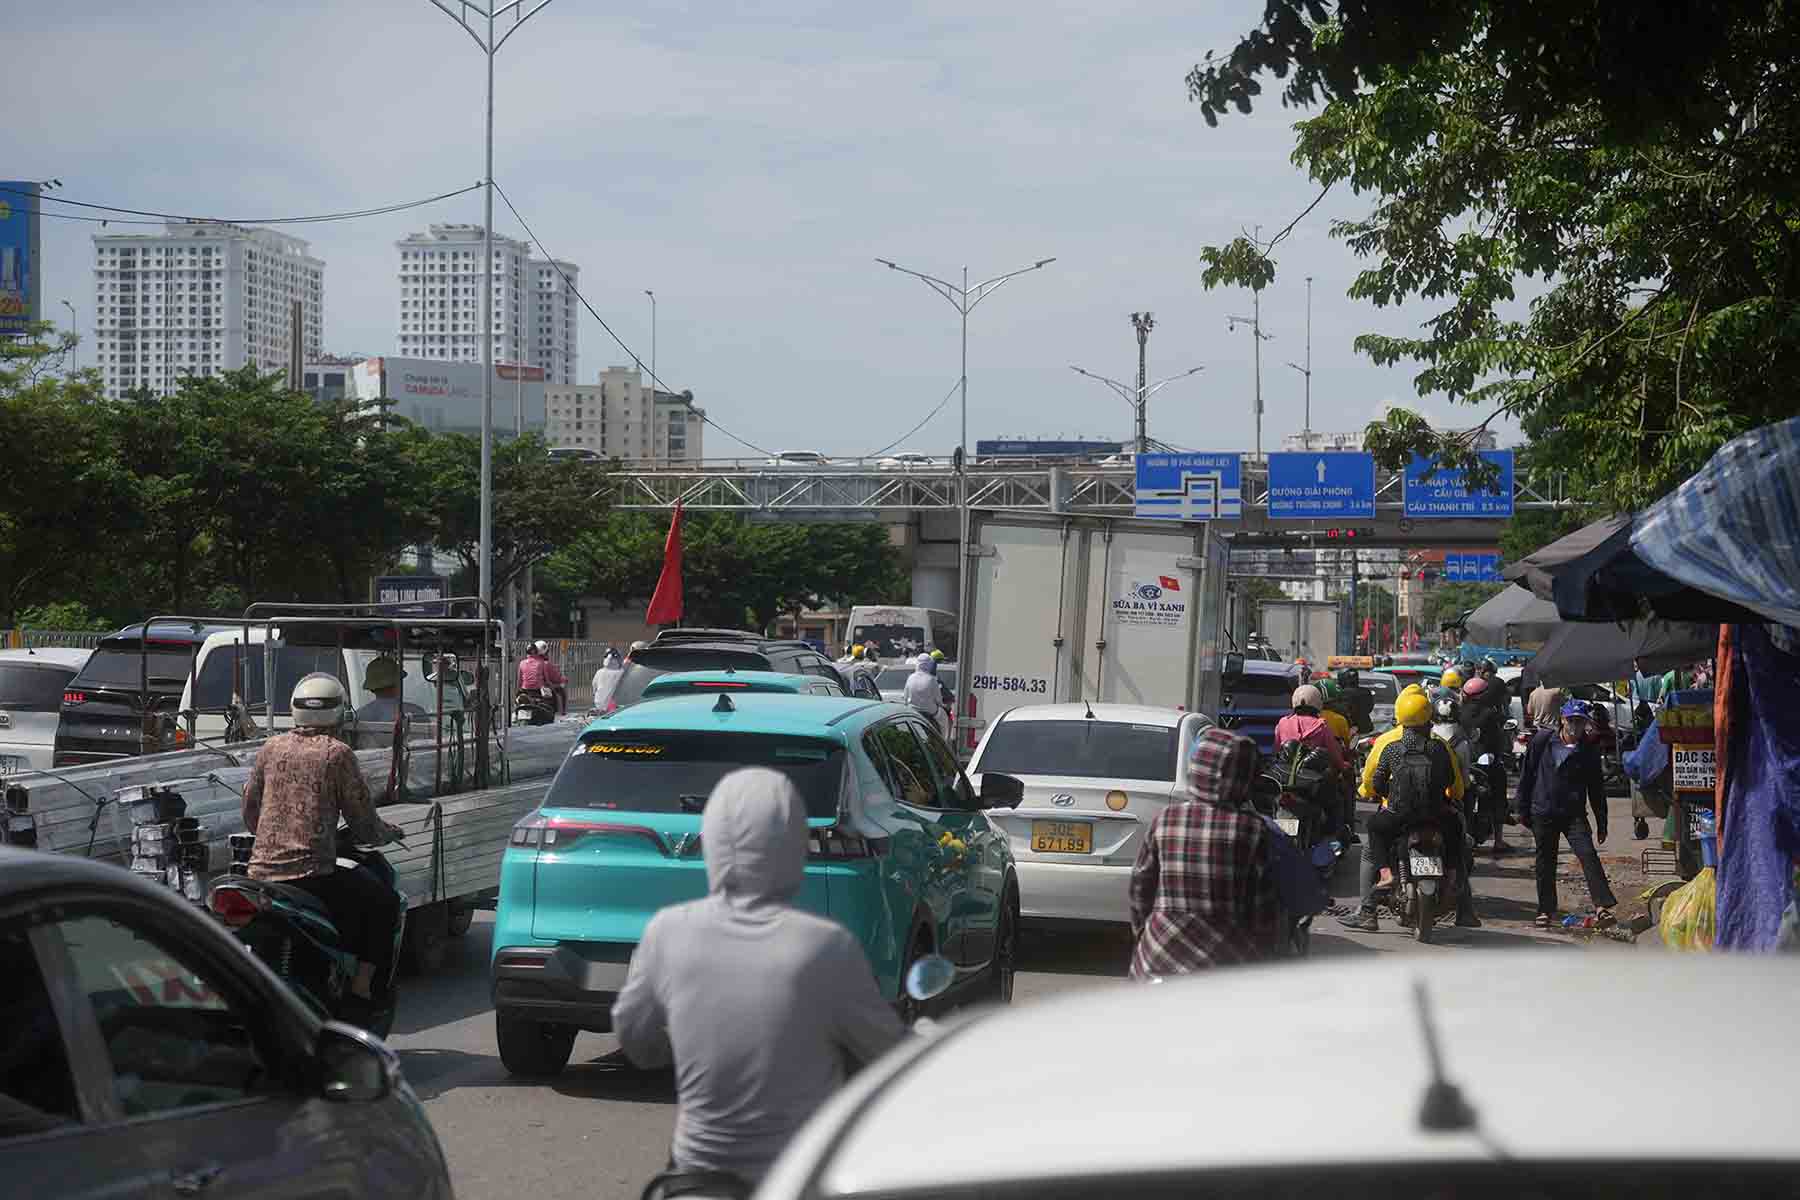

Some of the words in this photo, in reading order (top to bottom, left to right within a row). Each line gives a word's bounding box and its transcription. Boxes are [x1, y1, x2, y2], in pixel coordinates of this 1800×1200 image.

[1112, 600, 1130, 609] SỮA
[1133, 601, 1145, 610] BA
[1159, 603, 1185, 612] XANH
[973, 675, 1047, 693] 29H-584.33
[1675, 751, 1698, 765] ĐẶC
